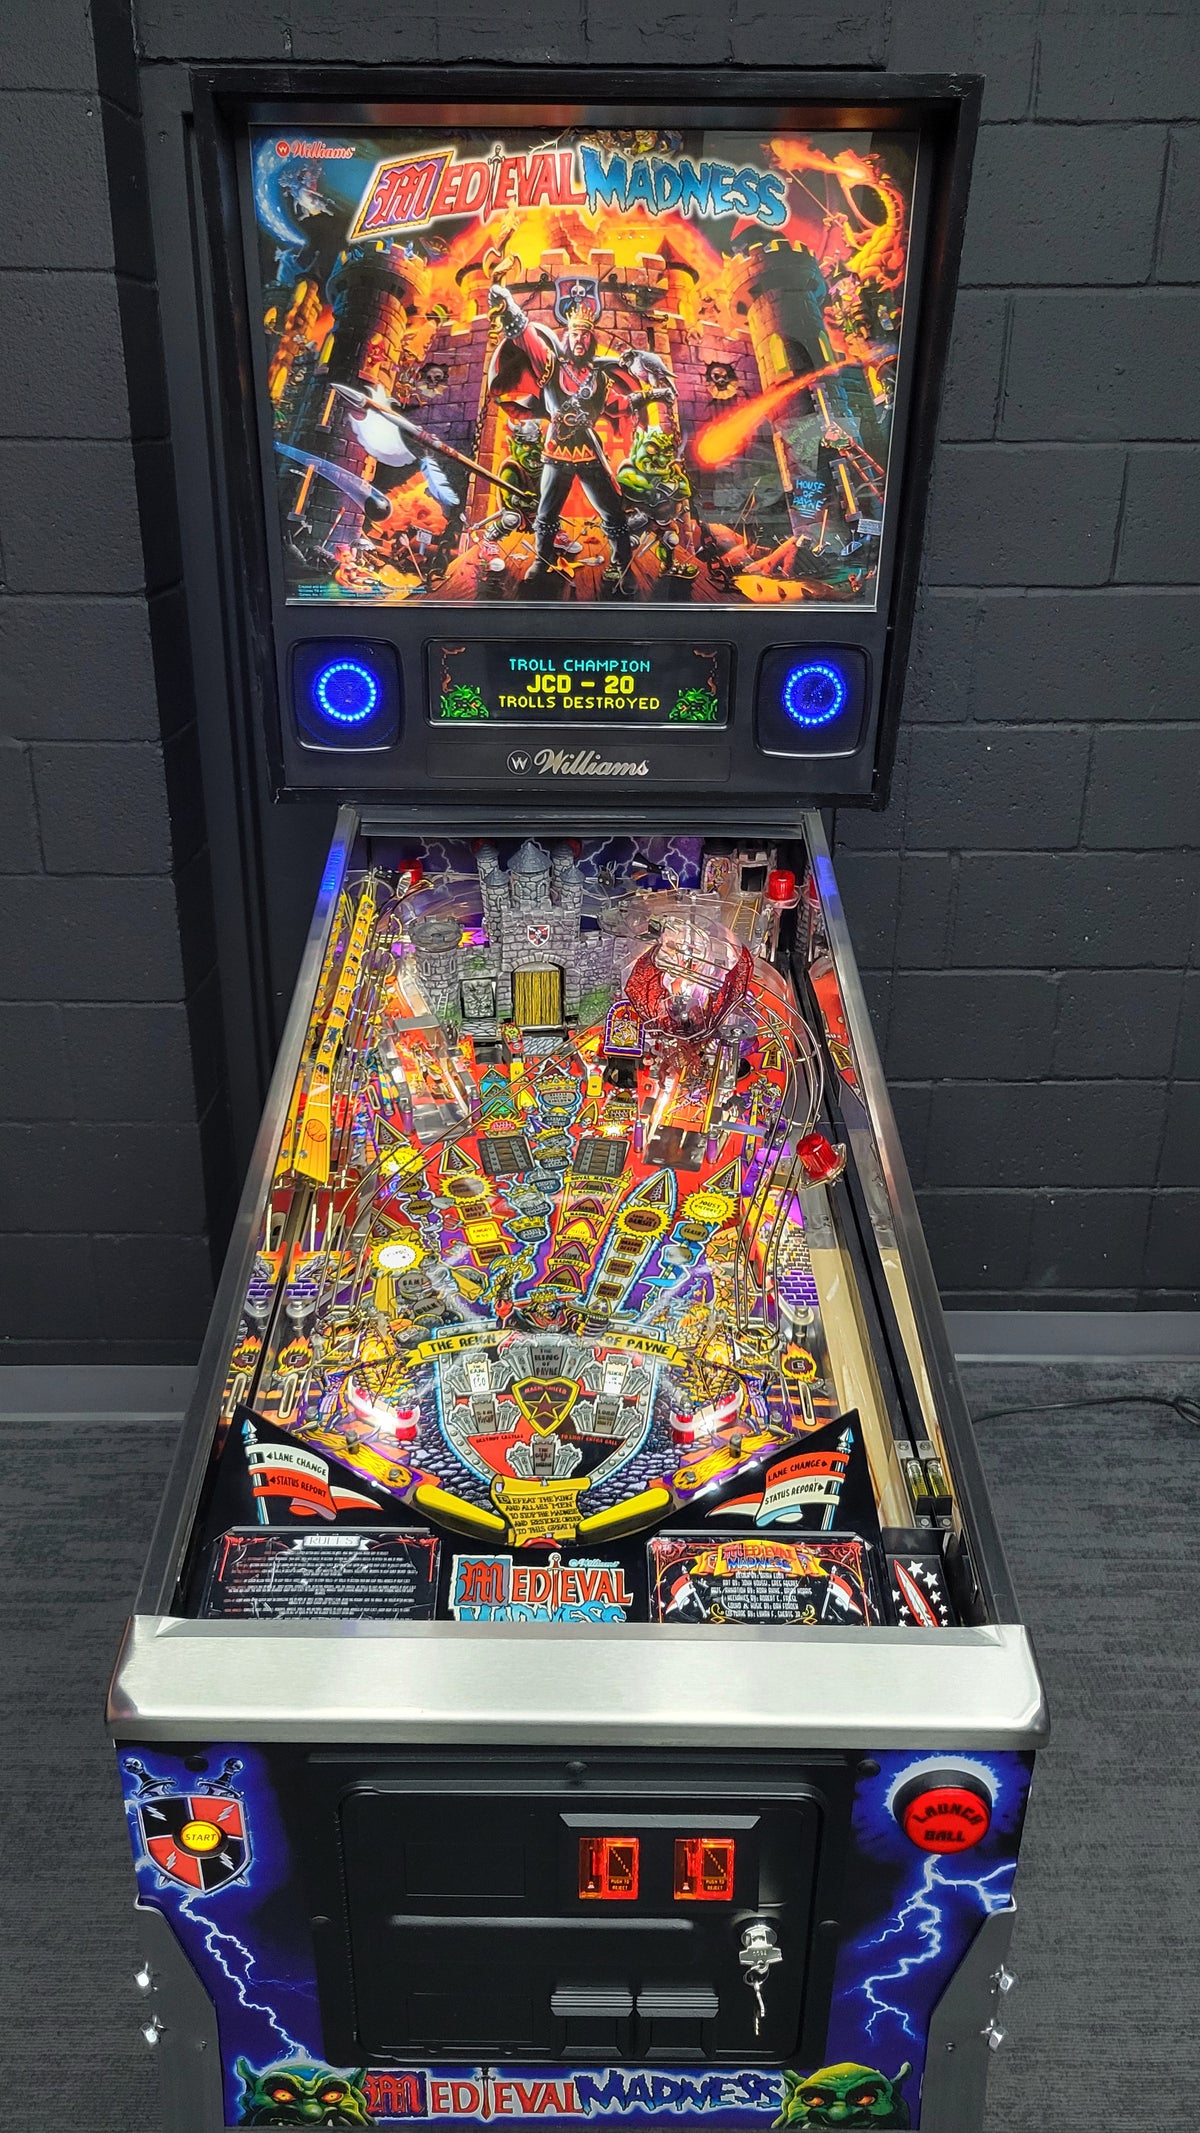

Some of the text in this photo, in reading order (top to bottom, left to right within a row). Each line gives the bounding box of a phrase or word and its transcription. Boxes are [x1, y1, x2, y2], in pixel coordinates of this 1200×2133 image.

[291, 140, 353, 159] Williams
[362, 145, 788, 230] MEDIEVAL MADNESS
[796, 480, 825, 494] HOUSE
[509, 658, 651, 672] TROLL CHAMPION
[526, 674, 572, 693] JCD
[604, 675, 635, 694] 20
[499, 695, 660, 710] TROLLS DESTROYED
[533, 748, 650, 776] Williams
[402, 1277, 425, 1287] BAM!
[428, 1332, 497, 1353] THE REIGN
[605, 1335, 669, 1355] OF PAYNE
[536, 1366, 559, 1376] PAYNE
[274, 1451, 327, 1477] LANE CHANGE
[768, 1459, 821, 1482] LANE CHANGE
[276, 1475, 326, 1498] STATUS REPORT
[764, 1481, 818, 1505] STATUS REPORT
[727, 1557, 791, 1571] MADNESS
[458, 1556, 633, 1607] MEDIEVAL
[912, 1803, 984, 1825] LAUNCH
[185, 1833, 217, 1841] START
[923, 1830, 966, 1842] BALL
[365, 2068, 783, 2119] MEDIEVAL MADNESS
